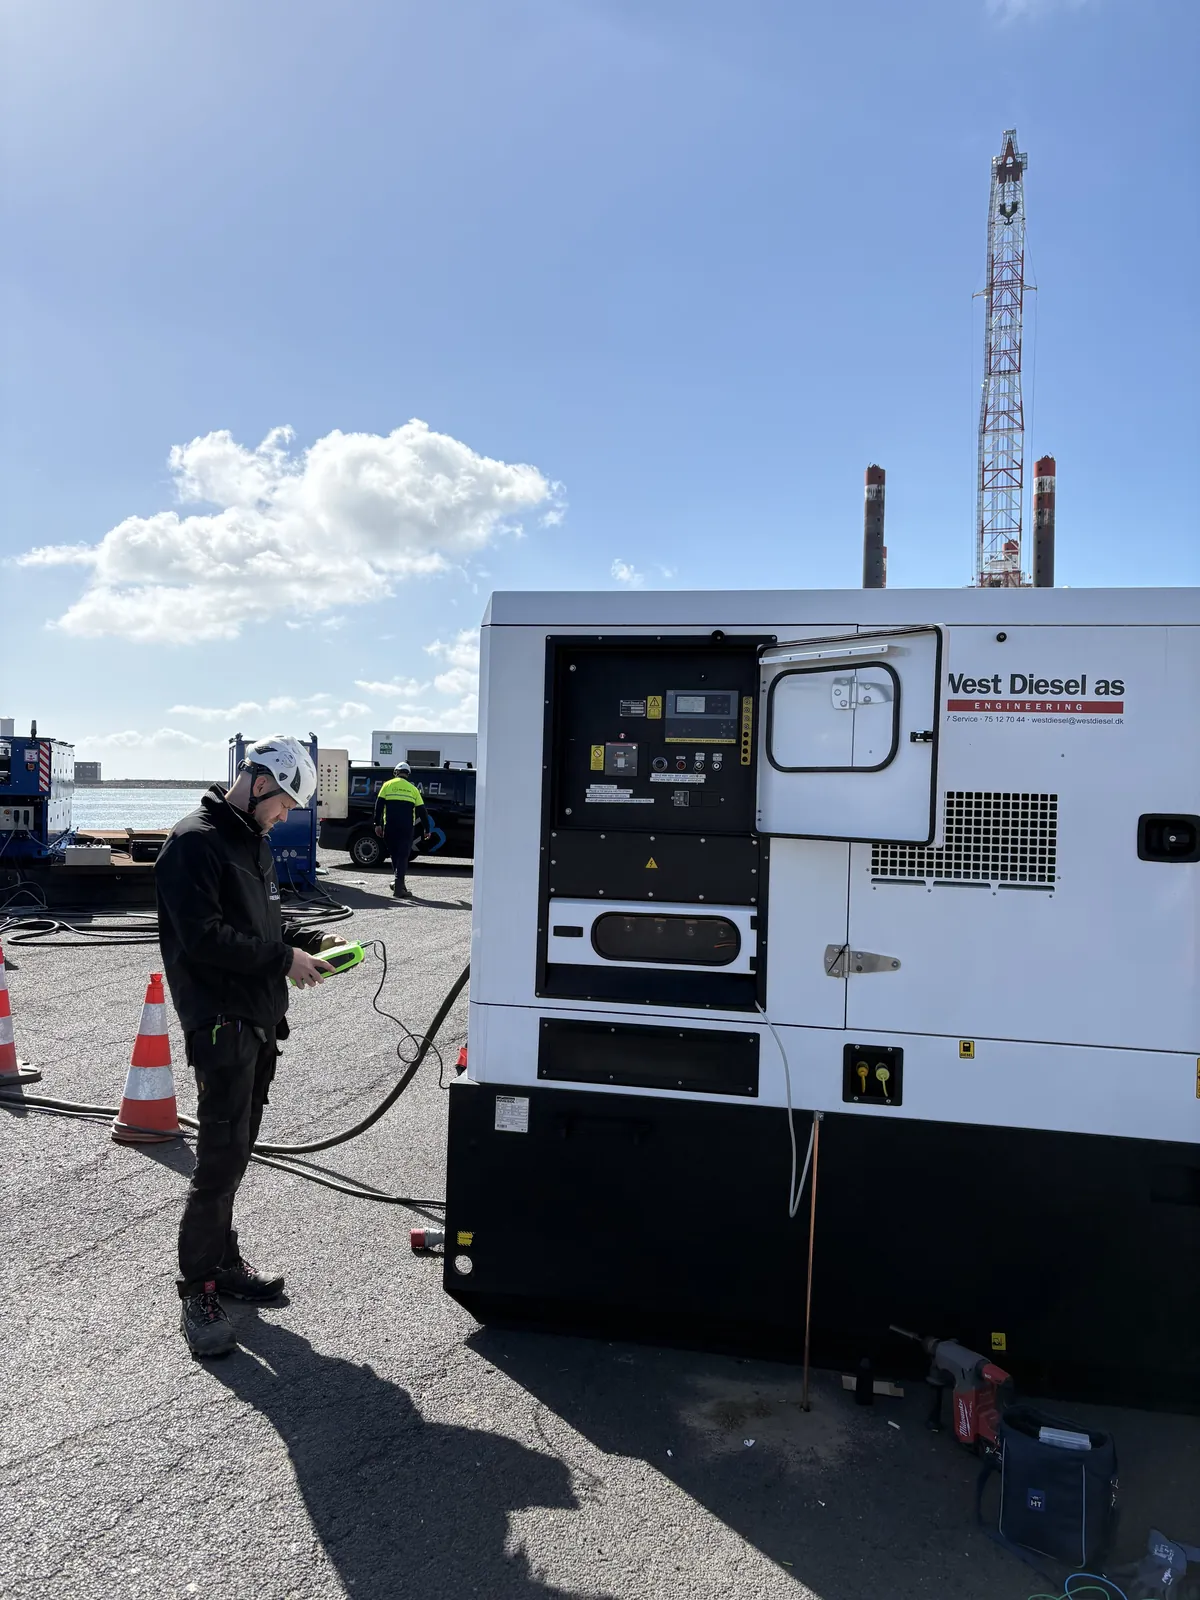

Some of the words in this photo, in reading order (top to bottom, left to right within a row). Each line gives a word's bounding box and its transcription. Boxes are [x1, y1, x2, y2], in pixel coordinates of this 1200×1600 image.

[1009, 673, 1087, 695] Diesel
[1094, 679, 1125, 696] as
[974, 702, 1083, 711] ENGINEERING
[952, 715, 978, 723] Service
[1031, 716, 1124, 726] westdiesel@westdiesel.dk
